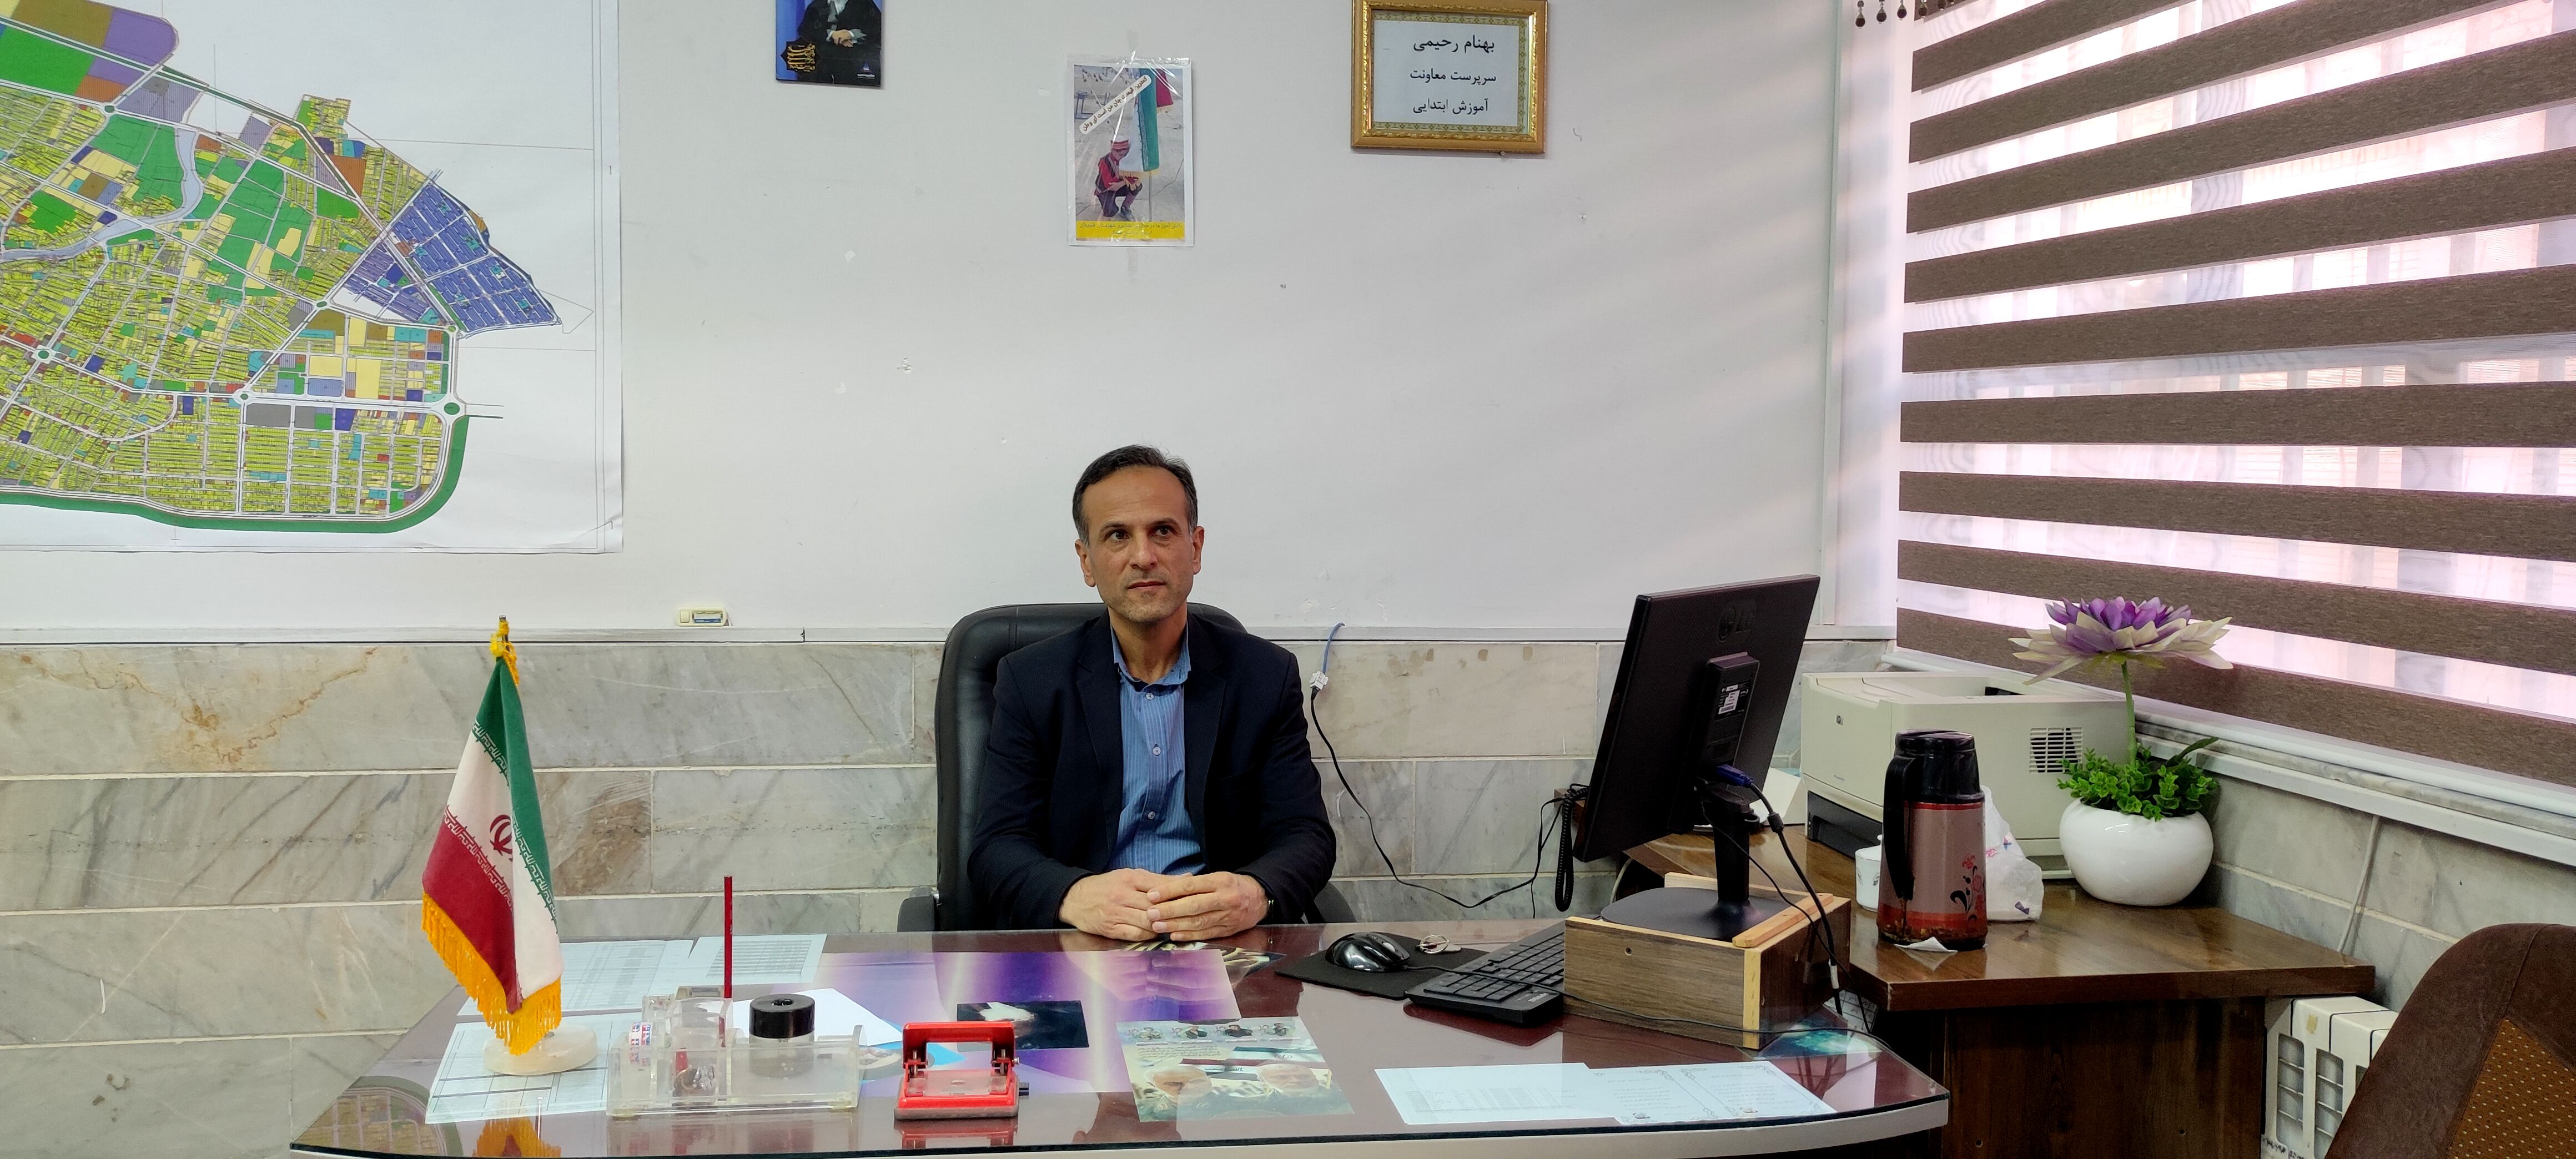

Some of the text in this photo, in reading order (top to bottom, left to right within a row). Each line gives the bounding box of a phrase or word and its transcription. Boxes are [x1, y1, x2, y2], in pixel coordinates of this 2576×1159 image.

[1413, 34, 1495, 54] بهنام رحیمی
[1410, 68, 1497, 85] سرپرست معاونت
[1412, 98, 1489, 115] آموزش ابتدایی
